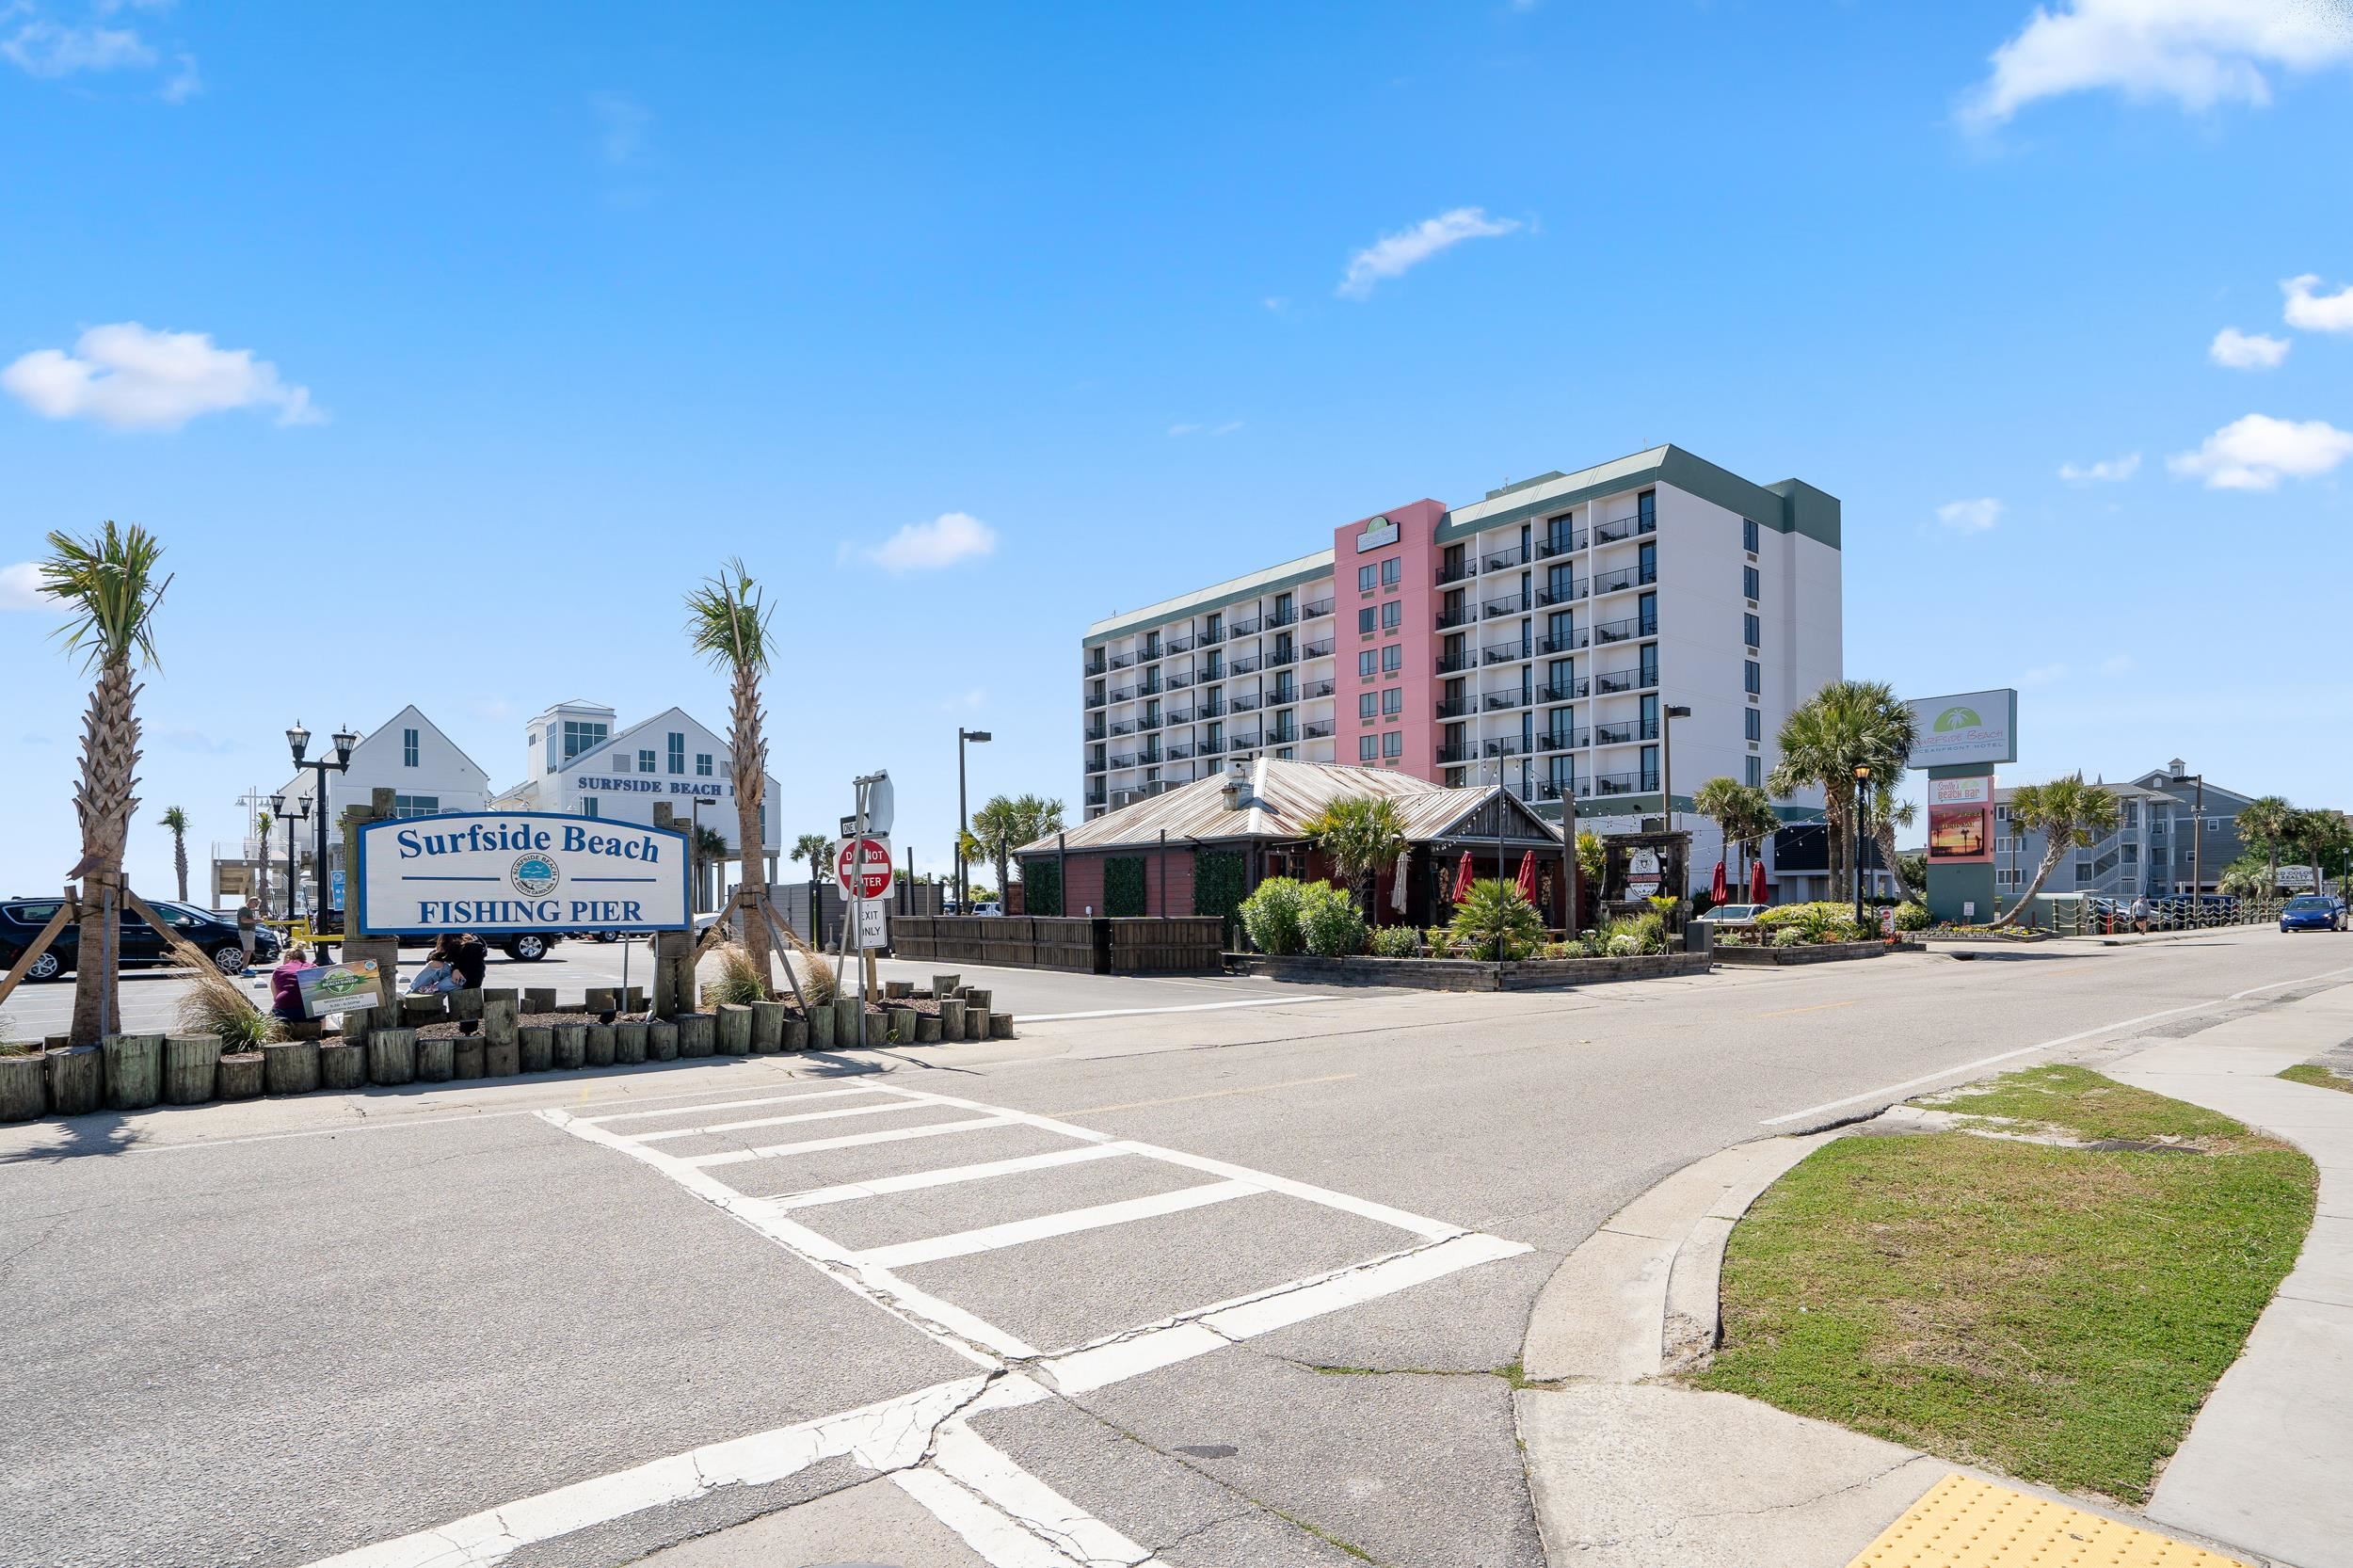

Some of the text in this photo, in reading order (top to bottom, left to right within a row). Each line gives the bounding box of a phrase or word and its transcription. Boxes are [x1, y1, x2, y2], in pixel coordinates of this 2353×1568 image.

[579, 777, 662, 792] SURFSIDE
[670, 782, 721, 796] BEACH
[843, 822, 854, 834] ONE
[397, 824, 660, 864] Surfside Beach
[513, 855, 557, 876] SURFSIDE BEACH
[517, 881, 531, 894] SOUTH
[418, 900, 644, 923] FISHING PIER
[862, 926, 881, 936] NLY
